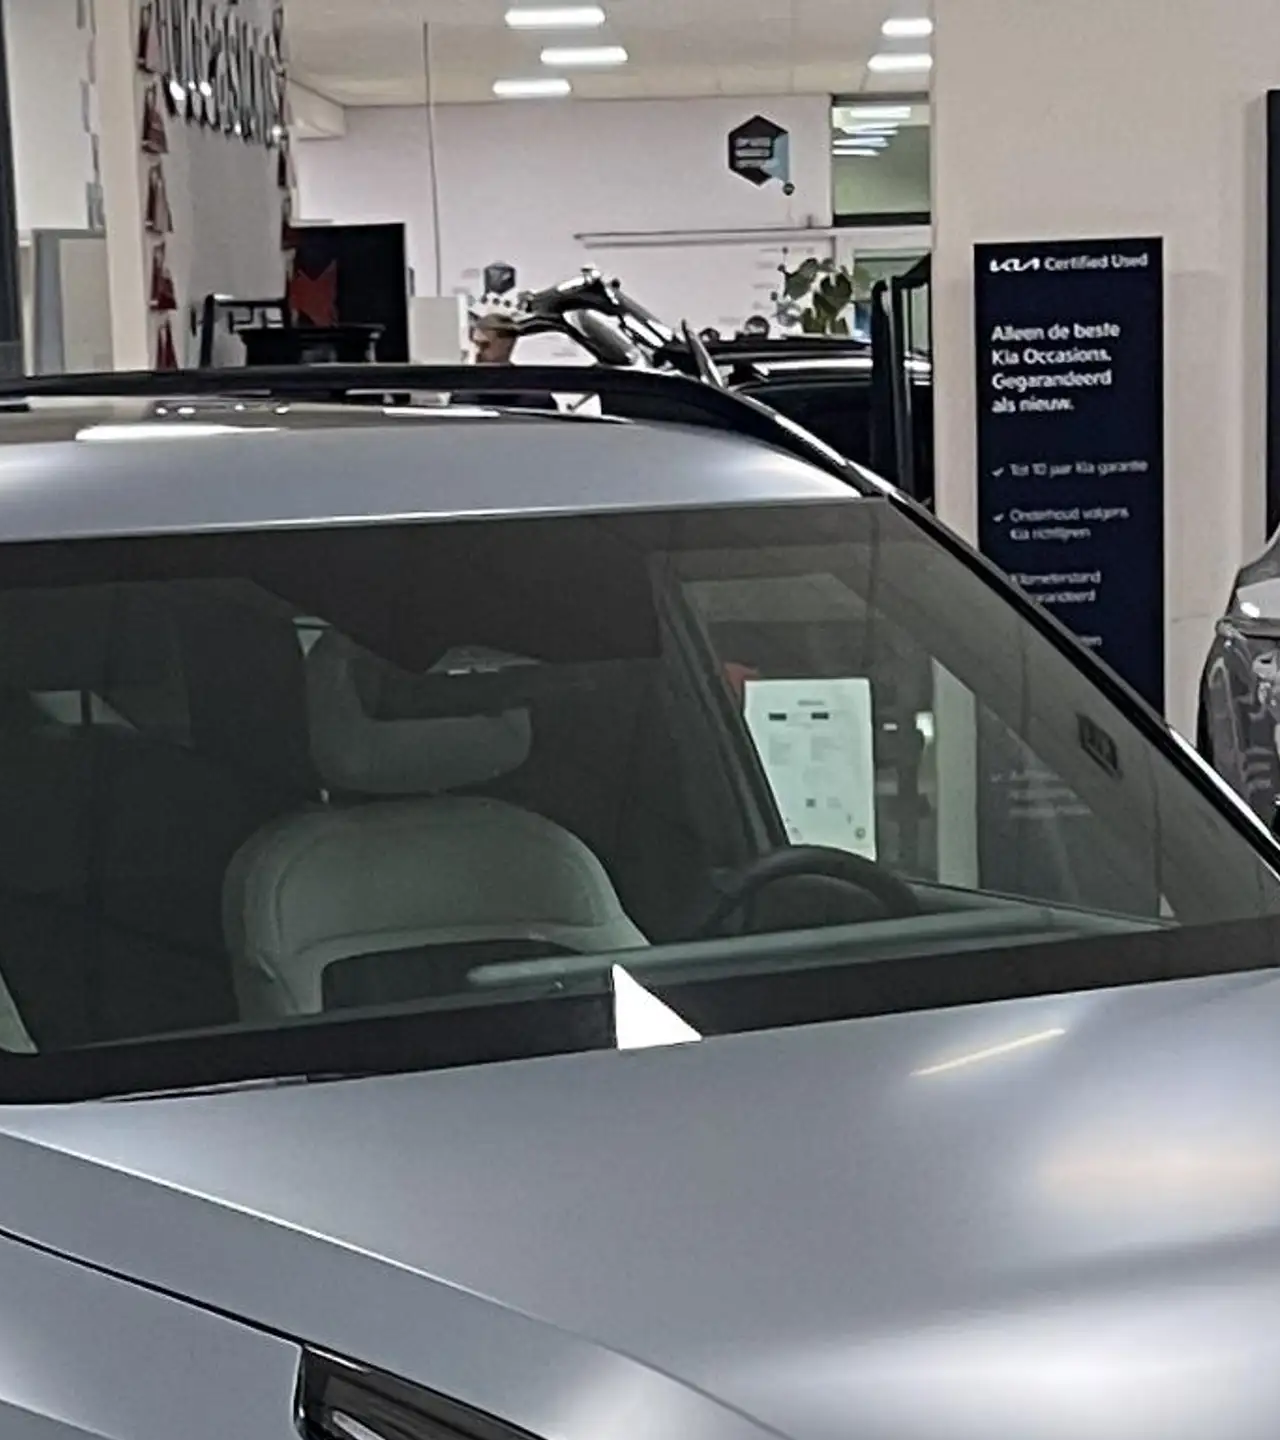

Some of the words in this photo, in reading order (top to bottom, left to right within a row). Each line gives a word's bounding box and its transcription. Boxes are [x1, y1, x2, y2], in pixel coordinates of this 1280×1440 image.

[1044, 255, 1109, 271] Certified
[1111, 253, 1148, 268] Used
[991, 325, 1045, 342] Alleen
[1047, 323, 1070, 340] de
[1073, 322, 1121, 339] beste
[991, 350, 1019, 365] Kia
[1023, 347, 1112, 364] Occasions.
[991, 369, 1113, 393] Gegarandeerd
[991, 396, 1016, 413] als
[1020, 394, 1075, 412] nieuw.
